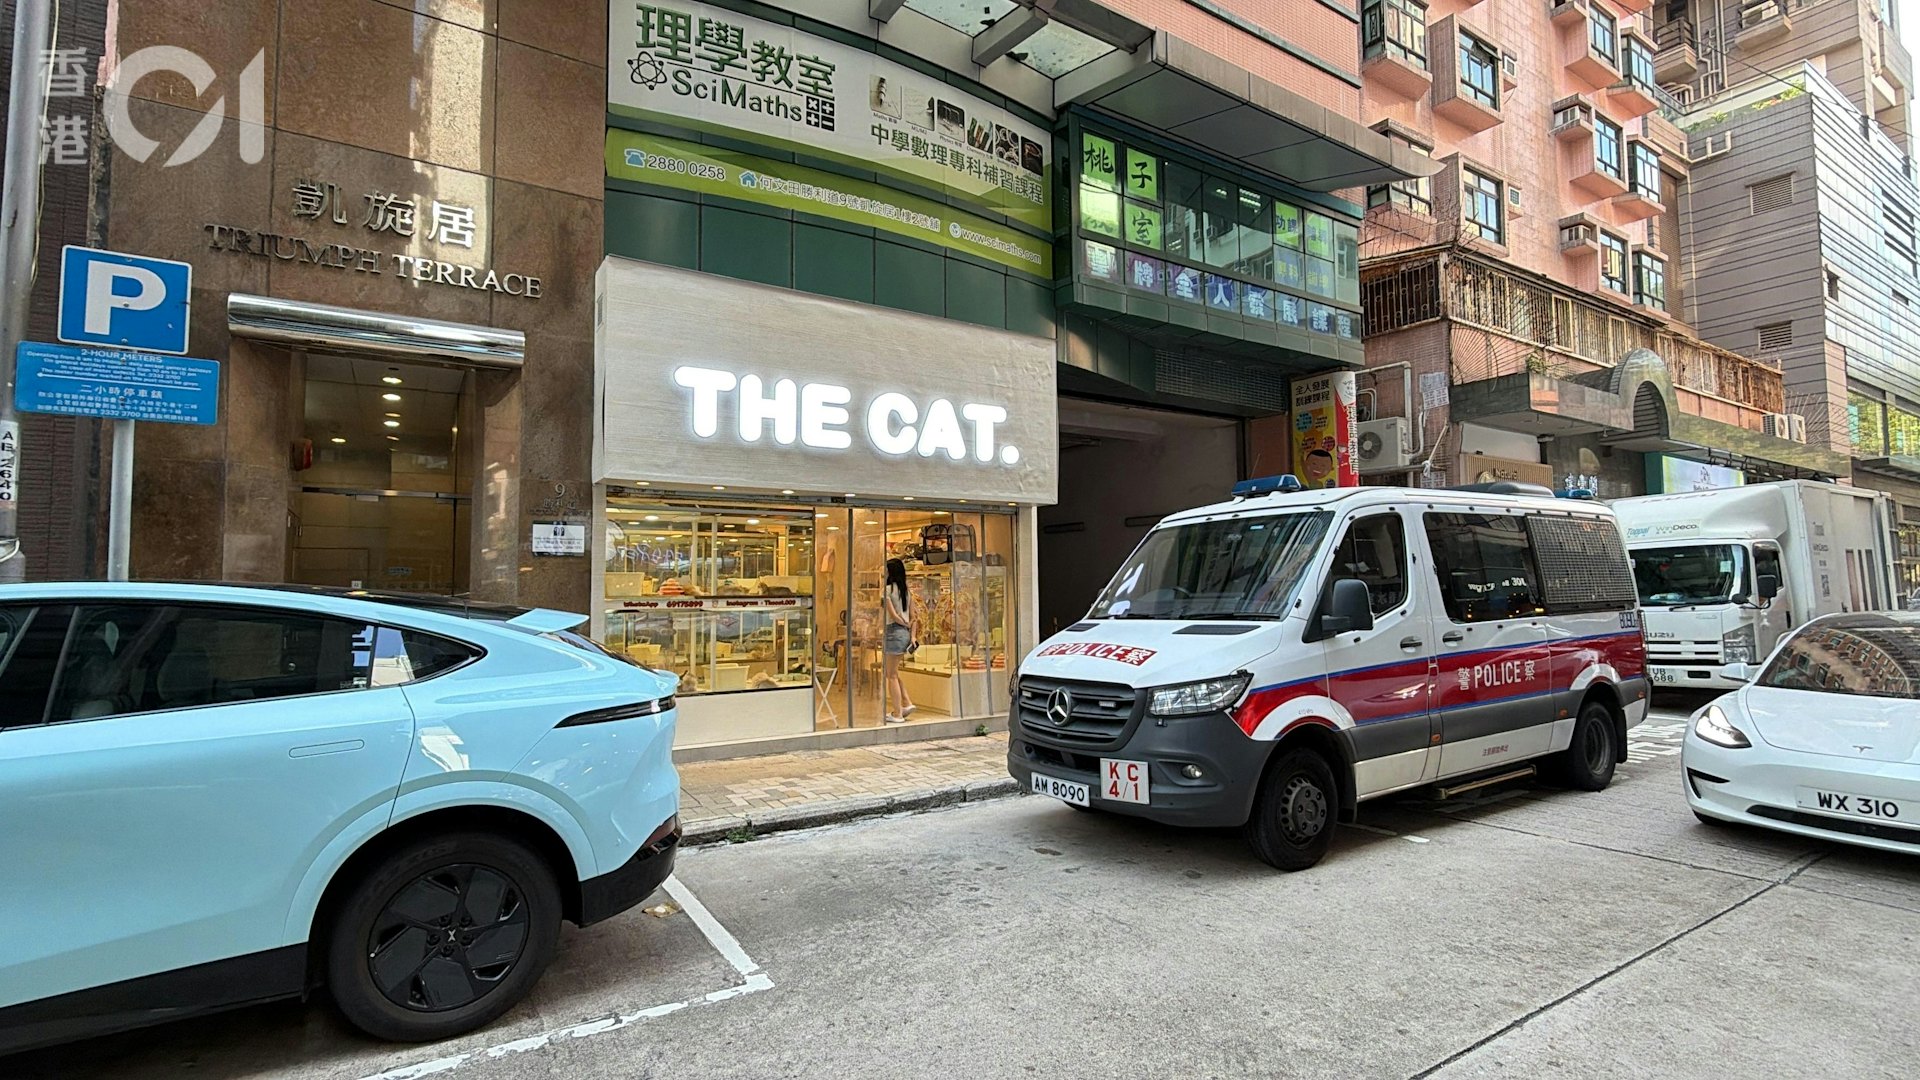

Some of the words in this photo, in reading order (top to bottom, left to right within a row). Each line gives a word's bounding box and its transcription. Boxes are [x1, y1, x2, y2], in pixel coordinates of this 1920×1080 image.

[636, 3, 836, 101] 理學教室
[671, 67, 803, 122] SciMaths
[648, 154, 687, 175] 2880
[688, 161, 726, 181] 0258
[870, 122, 1044, 205] 中學數理專科補習課程
[291, 178, 477, 250] 凱旋居
[203, 223, 382, 275] TRIUMPH
[391, 253, 545, 300] TERRACE
[961, 228, 1042, 265] www.scimaths.com
[84, 259, 167, 337] P
[81, 348, 120, 359] 2-HOUR
[120, 352, 162, 363] METERS
[674, 366, 852, 450] THE
[866, 391, 1020, 465] CAT.
[555, 483, 565, 498] 9
[1457, 667, 1470, 691] 警
[1474, 661, 1521, 688] POLICE
[1524, 660, 1535, 681] 察
[1034, 776, 1048, 793] AM
[1052, 784, 1085, 802] 8090
[1109, 762, 1119, 780] K
[1127, 764, 1139, 781] C
[1817, 792, 1849, 812] WX
[1856, 798, 1899, 818] 310
